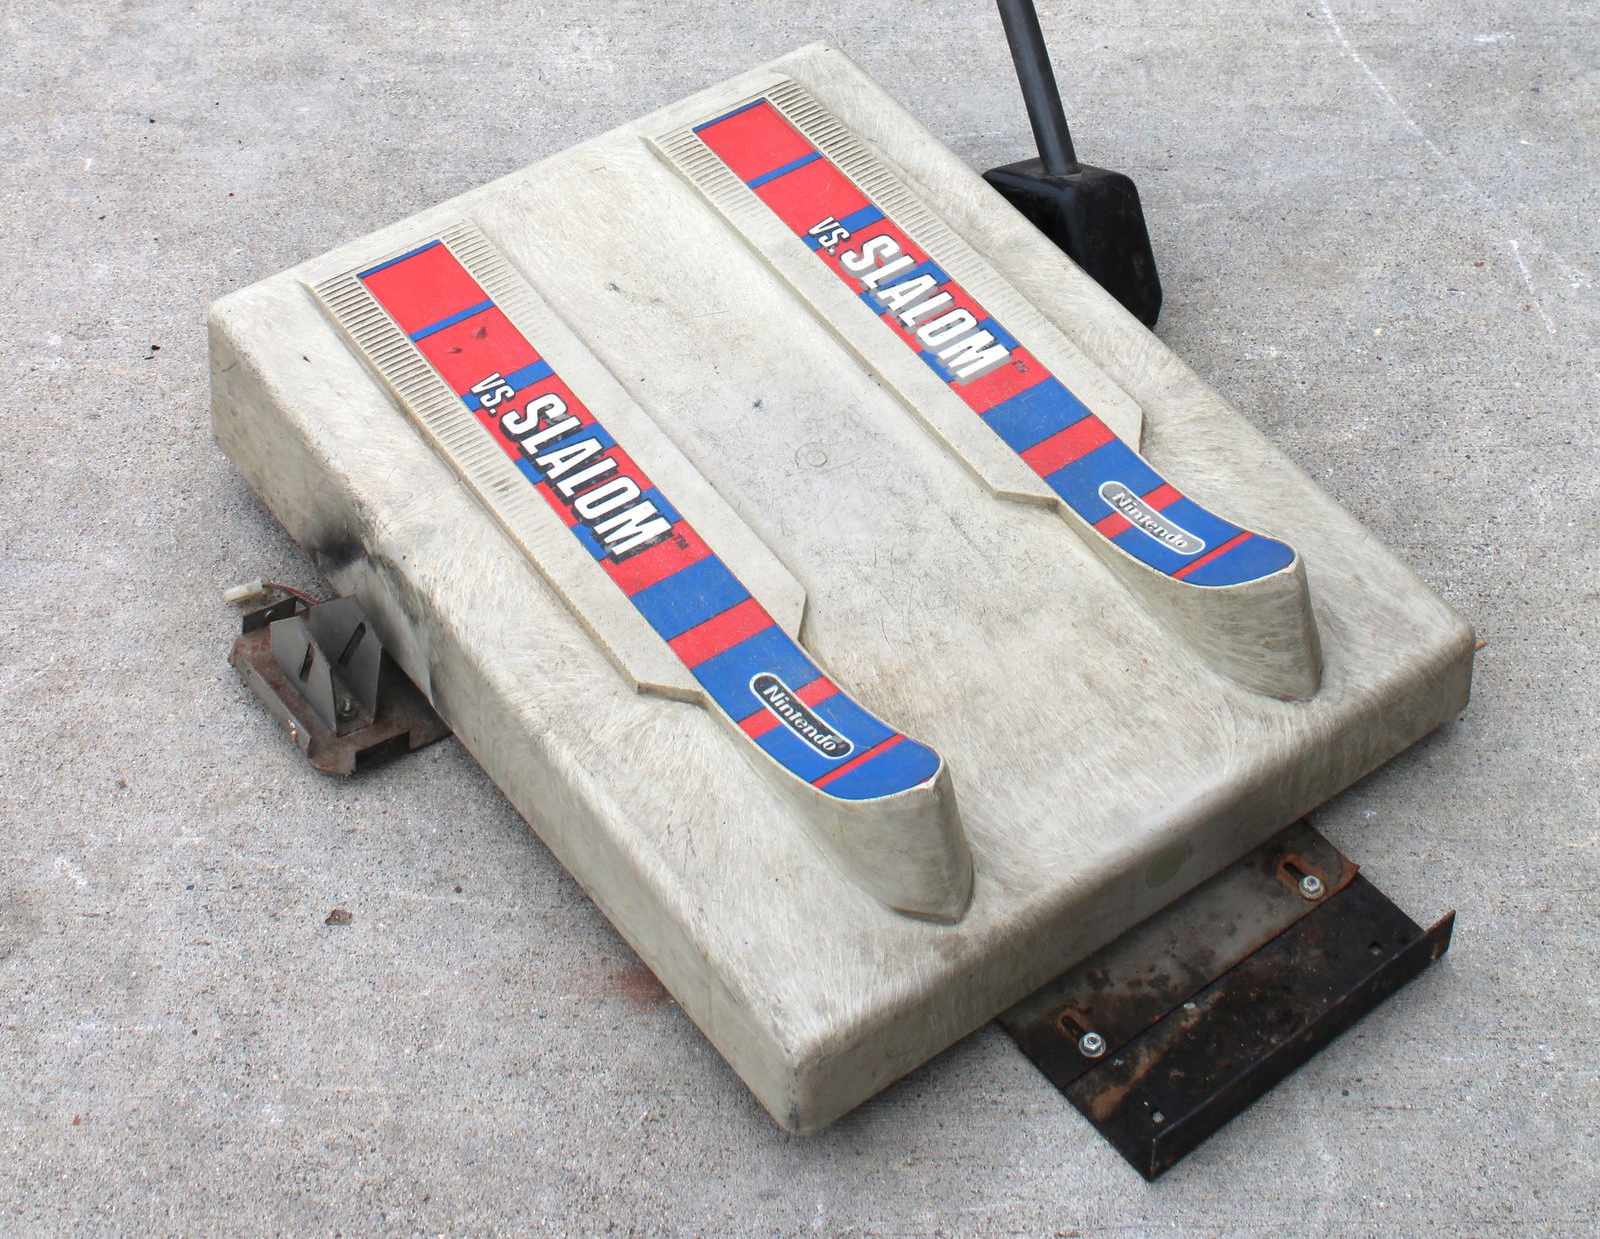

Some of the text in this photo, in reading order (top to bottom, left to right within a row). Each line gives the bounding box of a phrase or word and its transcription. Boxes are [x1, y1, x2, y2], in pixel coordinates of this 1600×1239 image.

[808, 216, 850, 255] VS.
[839, 234, 1012, 385] SLALOM
[470, 372, 515, 416] VS.
[499, 393, 674, 564] SLALOM
[1111, 491, 1188, 549] Nintendo
[762, 684, 837, 751] Nintendo
